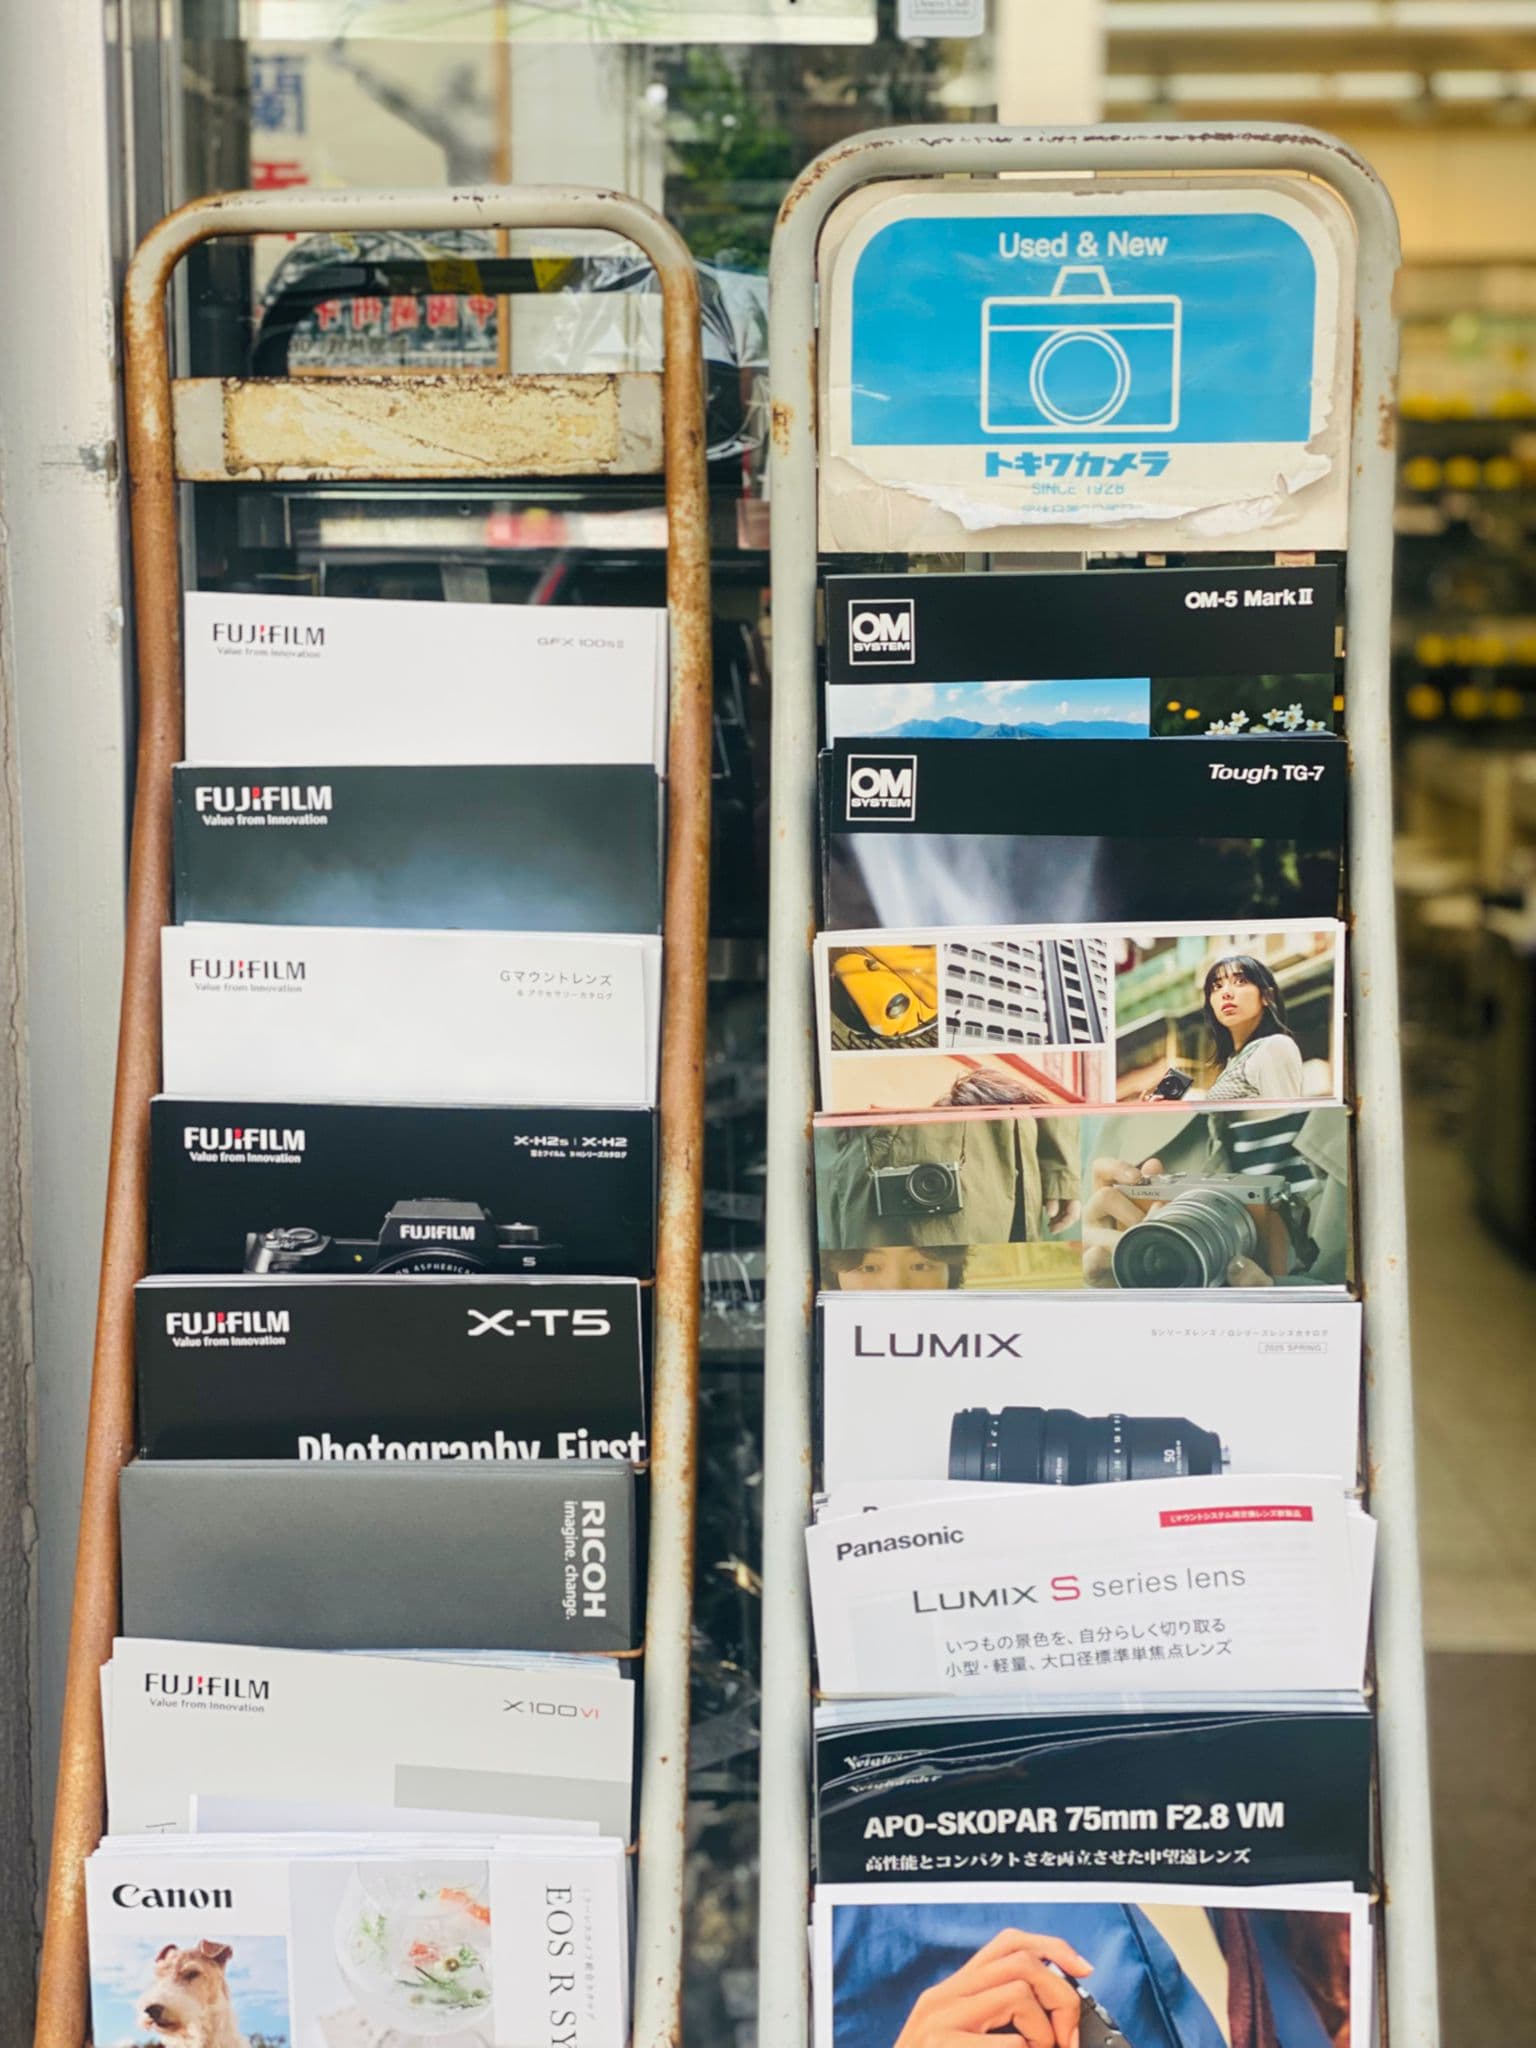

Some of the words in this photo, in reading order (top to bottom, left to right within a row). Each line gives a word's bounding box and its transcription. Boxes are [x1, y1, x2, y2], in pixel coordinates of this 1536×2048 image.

[999, 231, 1068, 259] Used
[1076, 230, 1098, 258] &
[1107, 230, 1168, 257] New
[985, 451, 1171, 477] トキワカメラ
[1184, 590, 1239, 609] OM-5
[212, 621, 325, 646] FUJIFILM
[852, 611, 911, 643] OM
[216, 646, 242, 656] Value
[245, 647, 269, 657] from
[271, 648, 321, 659] Innovation
[853, 641, 911, 652] SYSTEM
[850, 766, 913, 798] OM
[1208, 763, 1279, 785] Tough
[1282, 764, 1326, 781] TG-7
[195, 785, 333, 812] FUJIFILM
[850, 797, 912, 808] SYSTEM
[202, 814, 235, 826] Value
[236, 814, 266, 826] from
[267, 813, 329, 826] Innovation
[190, 958, 306, 980] FUJIFILM
[499, 969, 612, 986] Gマウントレンズ
[194, 982, 221, 992] Value
[224, 983, 248, 992] from
[250, 984, 303, 993] Innovation
[183, 1126, 306, 1151] FUJIFILM
[581, 1136, 628, 1147] X-H2
[189, 1151, 219, 1162] Value
[220, 1151, 246, 1162] from
[247, 1152, 302, 1163] Innovation
[400, 1224, 476, 1241] FUJIFILM
[166, 1310, 290, 1335] FUJIFILM
[467, 1309, 612, 1336] X-T5
[171, 1337, 202, 1347] Value
[203, 1336, 230, 1346] from
[231, 1335, 287, 1346] Innovation
[854, 1325, 1024, 1358] LUMIX
[561, 1501, 579, 1561] imagine.
[836, 1525, 965, 1562] Panasonic
[581, 1500, 607, 1617] RICOH
[562, 1564, 579, 1621] change.
[913, 1585, 1039, 1613] LUMIX
[1051, 1575, 1081, 1601] S
[1092, 1572, 1178, 1598] series
[1186, 1567, 1247, 1590] lens
[946, 1617, 1227, 1655] いつもの景色を、自分らしく切り取る
[945, 1638, 1233, 1678] 小型・軽量、大口径標準単焦点レンズ
[145, 1672, 270, 1700] FUJIFILM
[149, 1697, 178, 1707] Value
[181, 1699, 207, 1709] from
[209, 1701, 266, 1714] Innovation
[863, 1807, 1058, 1839] APO-SKOPAR
[1064, 1805, 1158, 1833] 75mm
[1166, 1803, 1230, 1831] F2.8
[1236, 1801, 1286, 1829] VM
[865, 1847, 1252, 1873] 高性能とコンパクトさを両立させた中望遠レンズ
[112, 1883, 233, 1909] Canon
[545, 1884, 575, 1957] EOS
[549, 1972, 576, 1996] R
